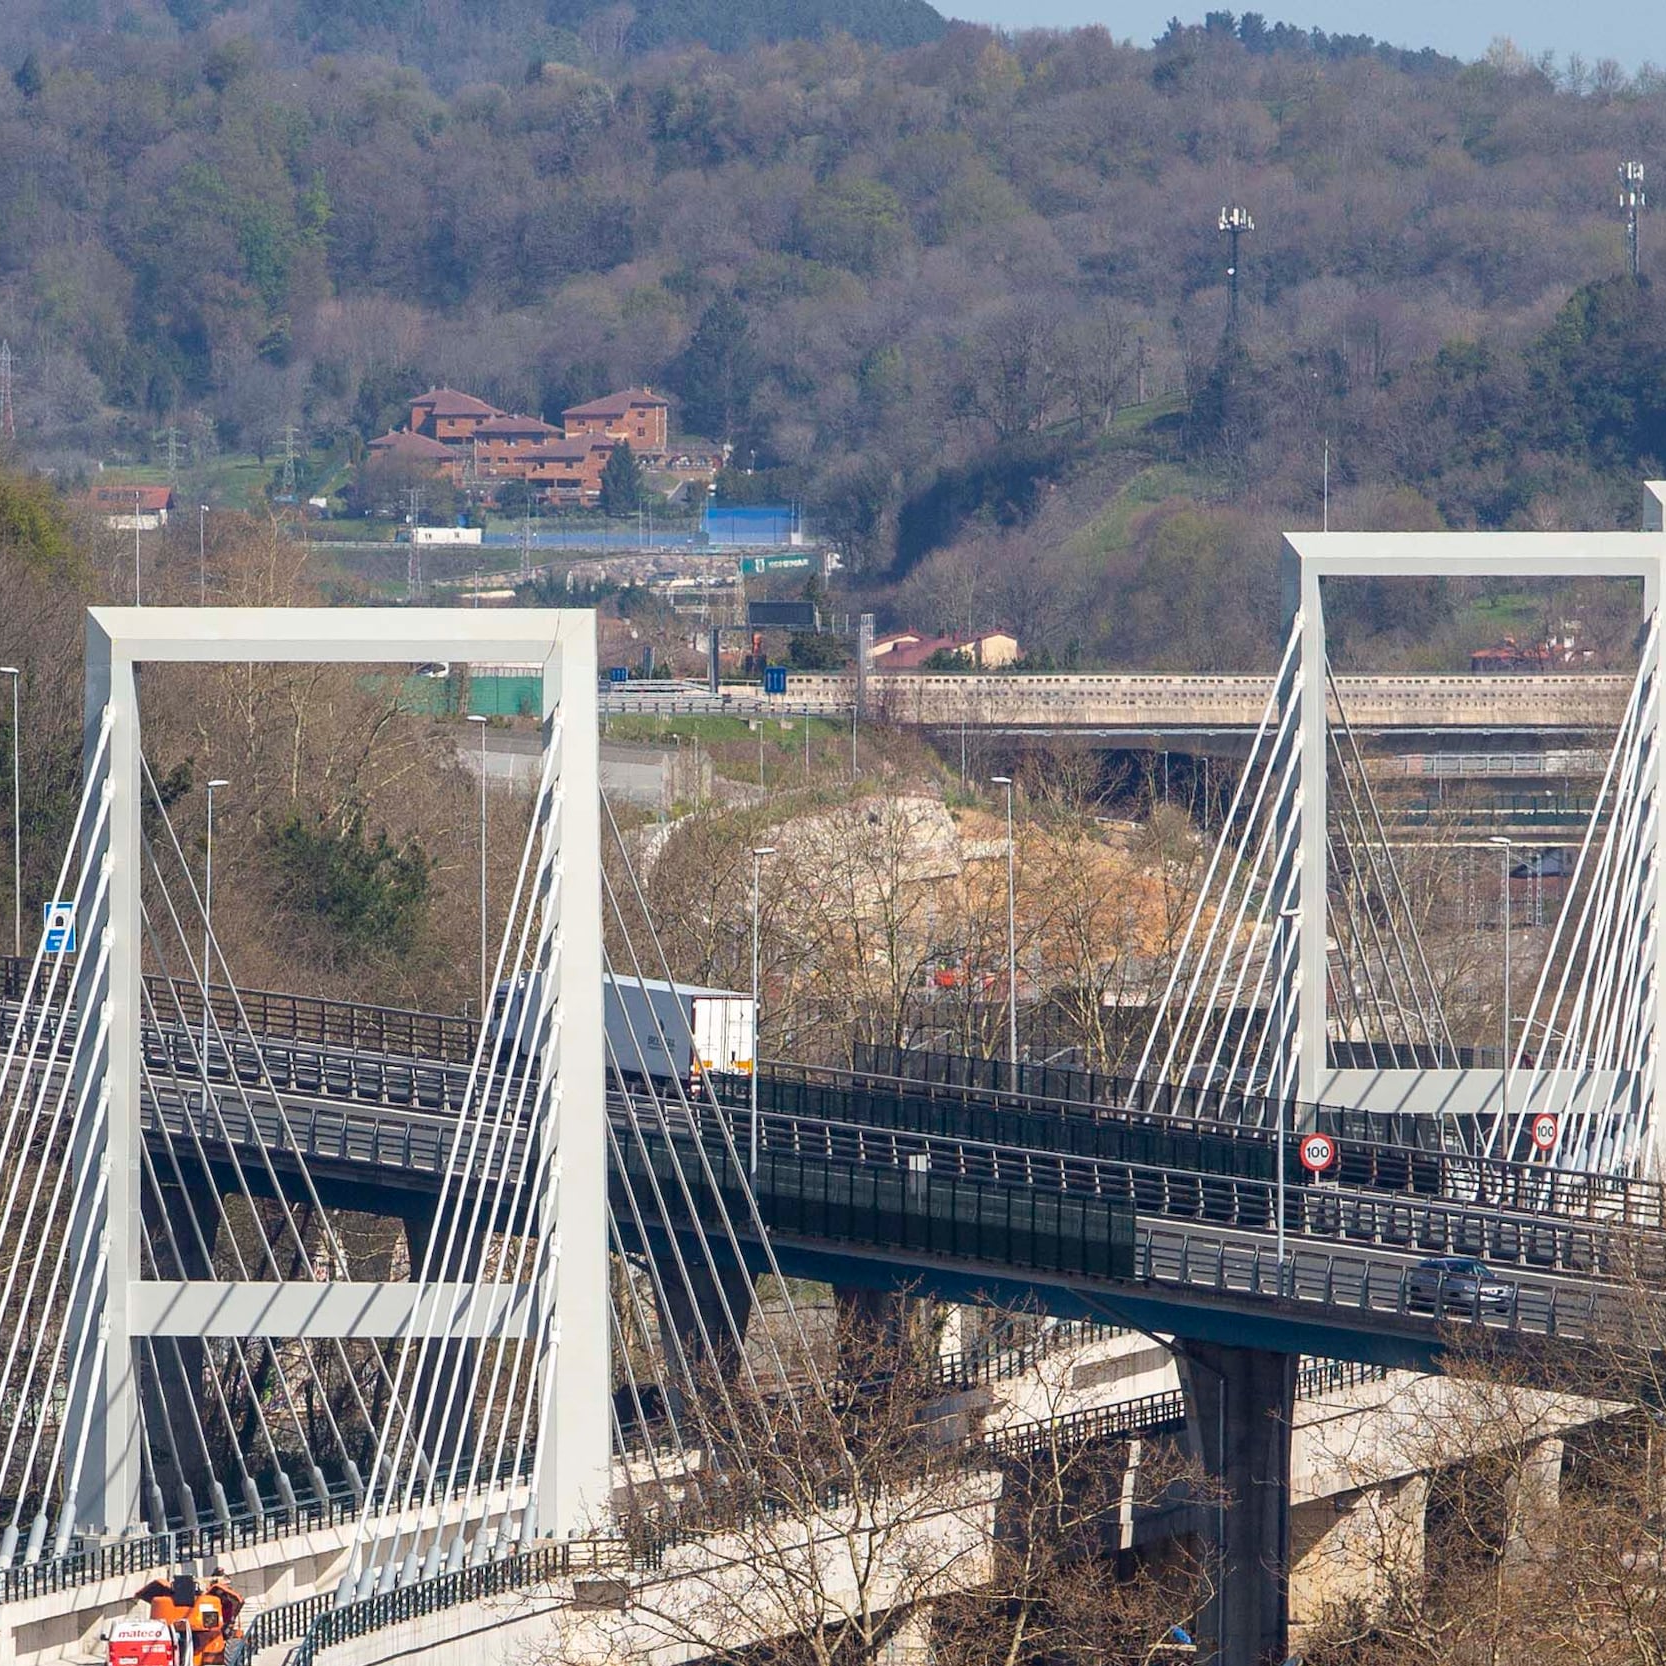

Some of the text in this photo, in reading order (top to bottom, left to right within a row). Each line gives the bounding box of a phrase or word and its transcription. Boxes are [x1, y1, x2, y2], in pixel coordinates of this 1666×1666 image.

[1537, 1125, 1554, 1137] 100
[1307, 1146, 1329, 1158] 100
[118, 1630, 162, 1638] mateco
